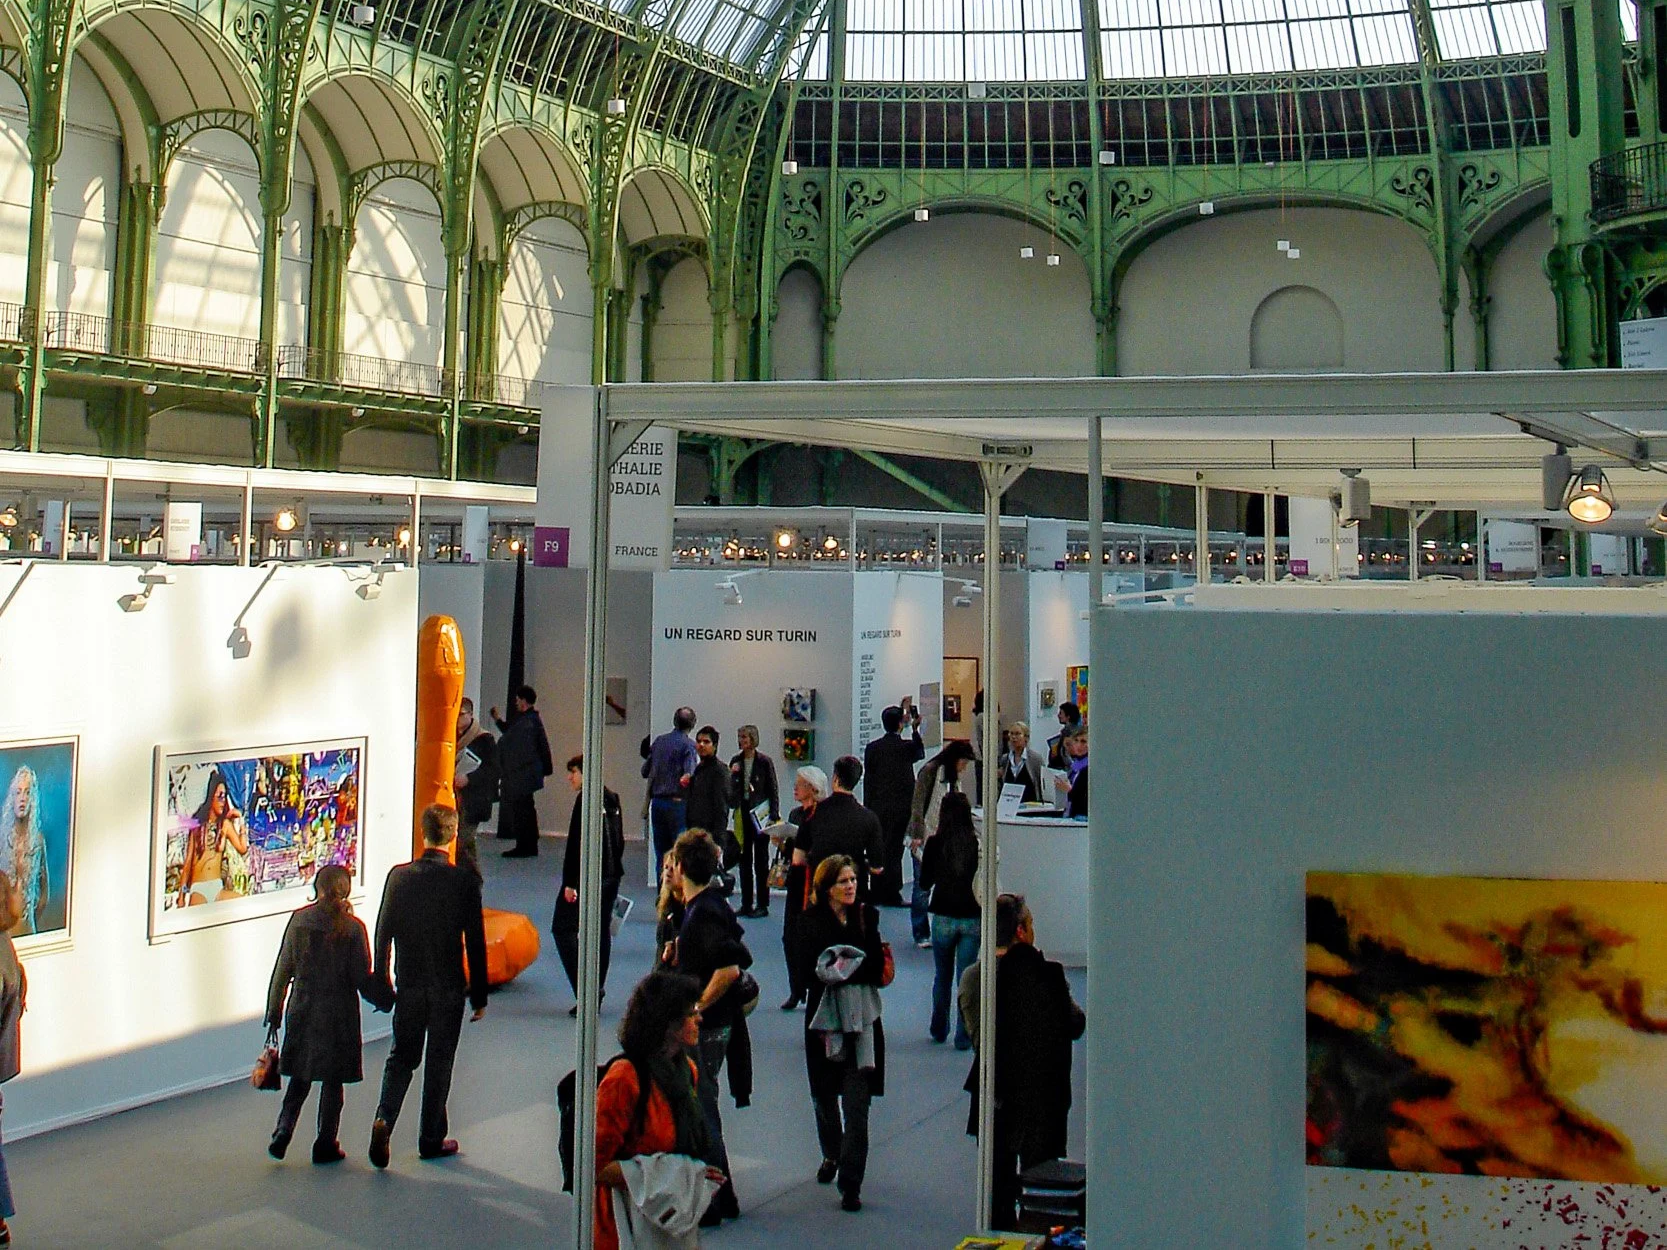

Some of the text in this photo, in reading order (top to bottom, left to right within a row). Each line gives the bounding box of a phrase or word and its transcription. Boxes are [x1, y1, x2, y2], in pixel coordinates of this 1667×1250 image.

[624, 442, 664, 456] ERIE
[544, 541, 559, 553] F9
[615, 546, 658, 557] FRANCE
[664, 627, 817, 643] UN REGARD SUR TURIN
